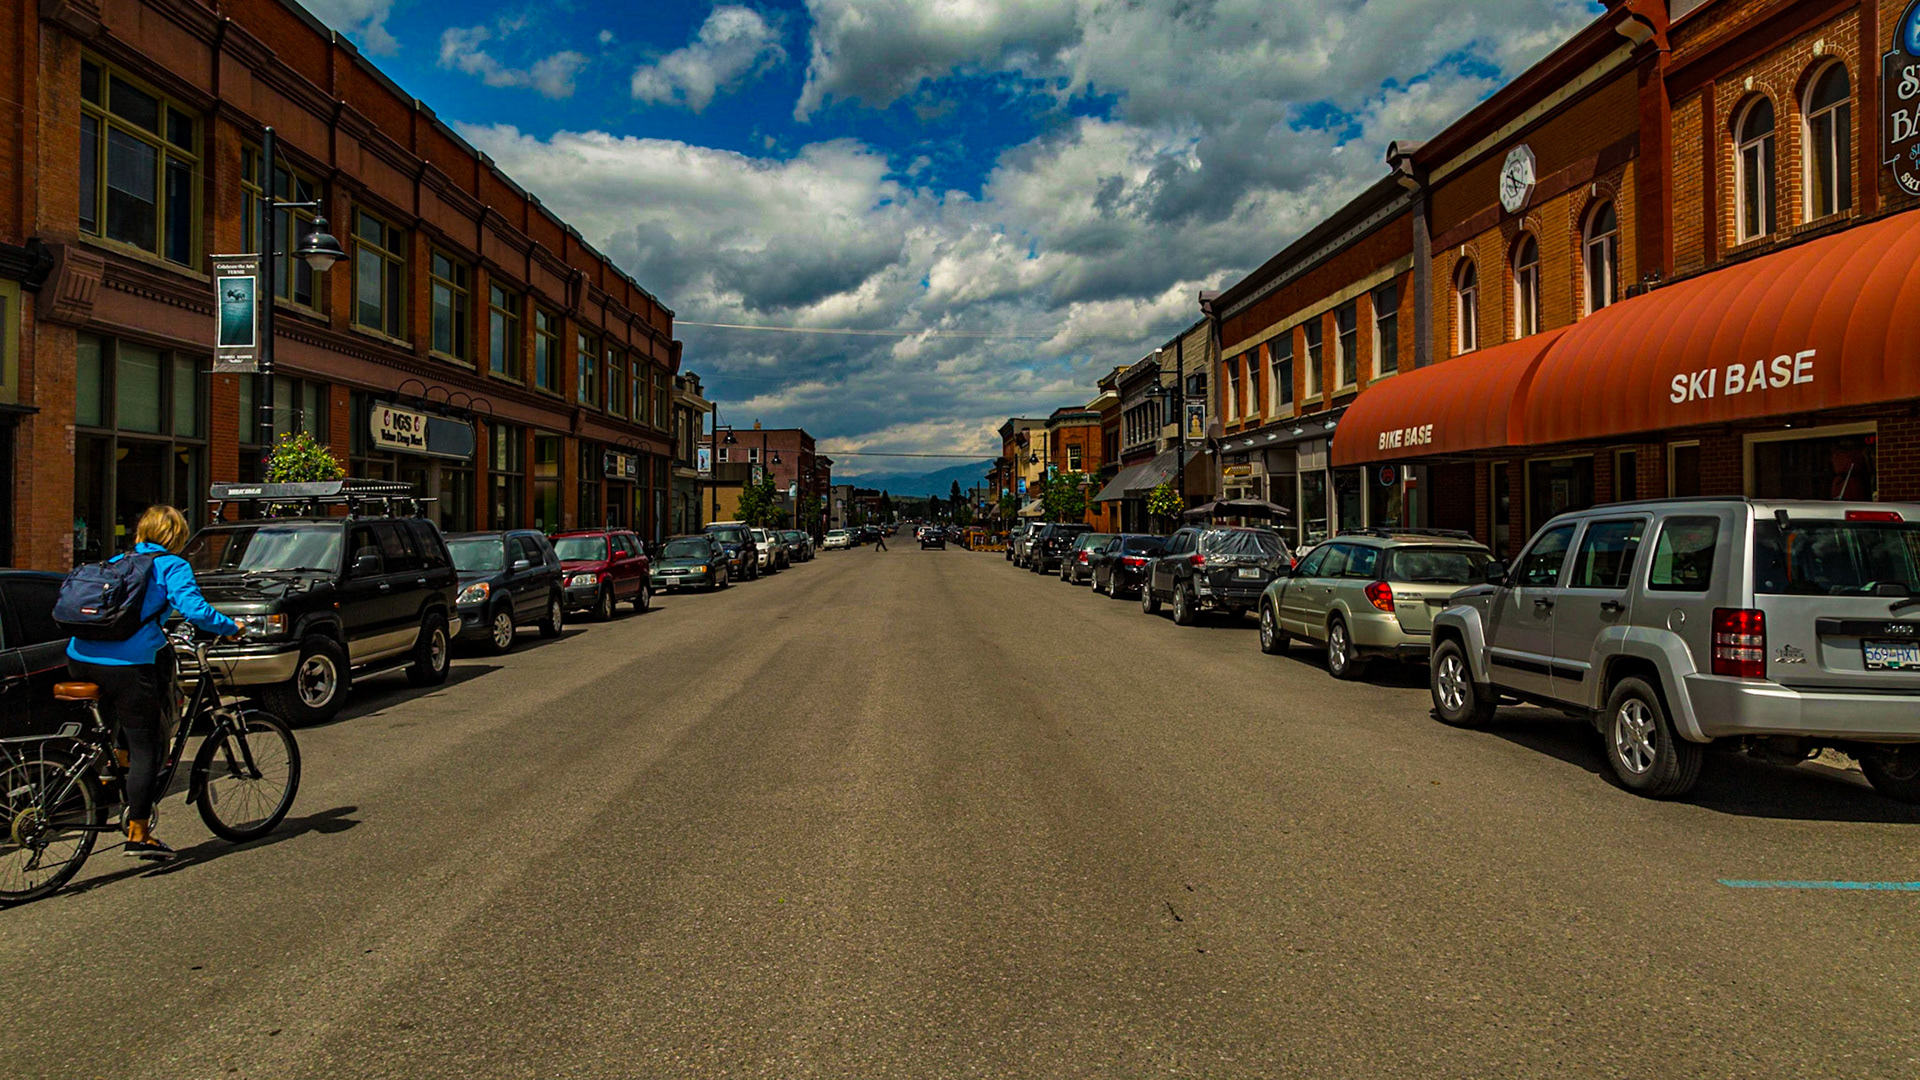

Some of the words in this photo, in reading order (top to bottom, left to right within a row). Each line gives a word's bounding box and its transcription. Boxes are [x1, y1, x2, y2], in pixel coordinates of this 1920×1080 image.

[1897, 64, 1920, 100] S
[1670, 368, 1717, 404] SKI
[1724, 349, 1817, 396] BASE
[397, 431, 410, 447] Drug
[1378, 429, 1404, 450] BIKE
[1404, 423, 1434, 447] BASE
[1884, 622, 1914, 636] Jeep
